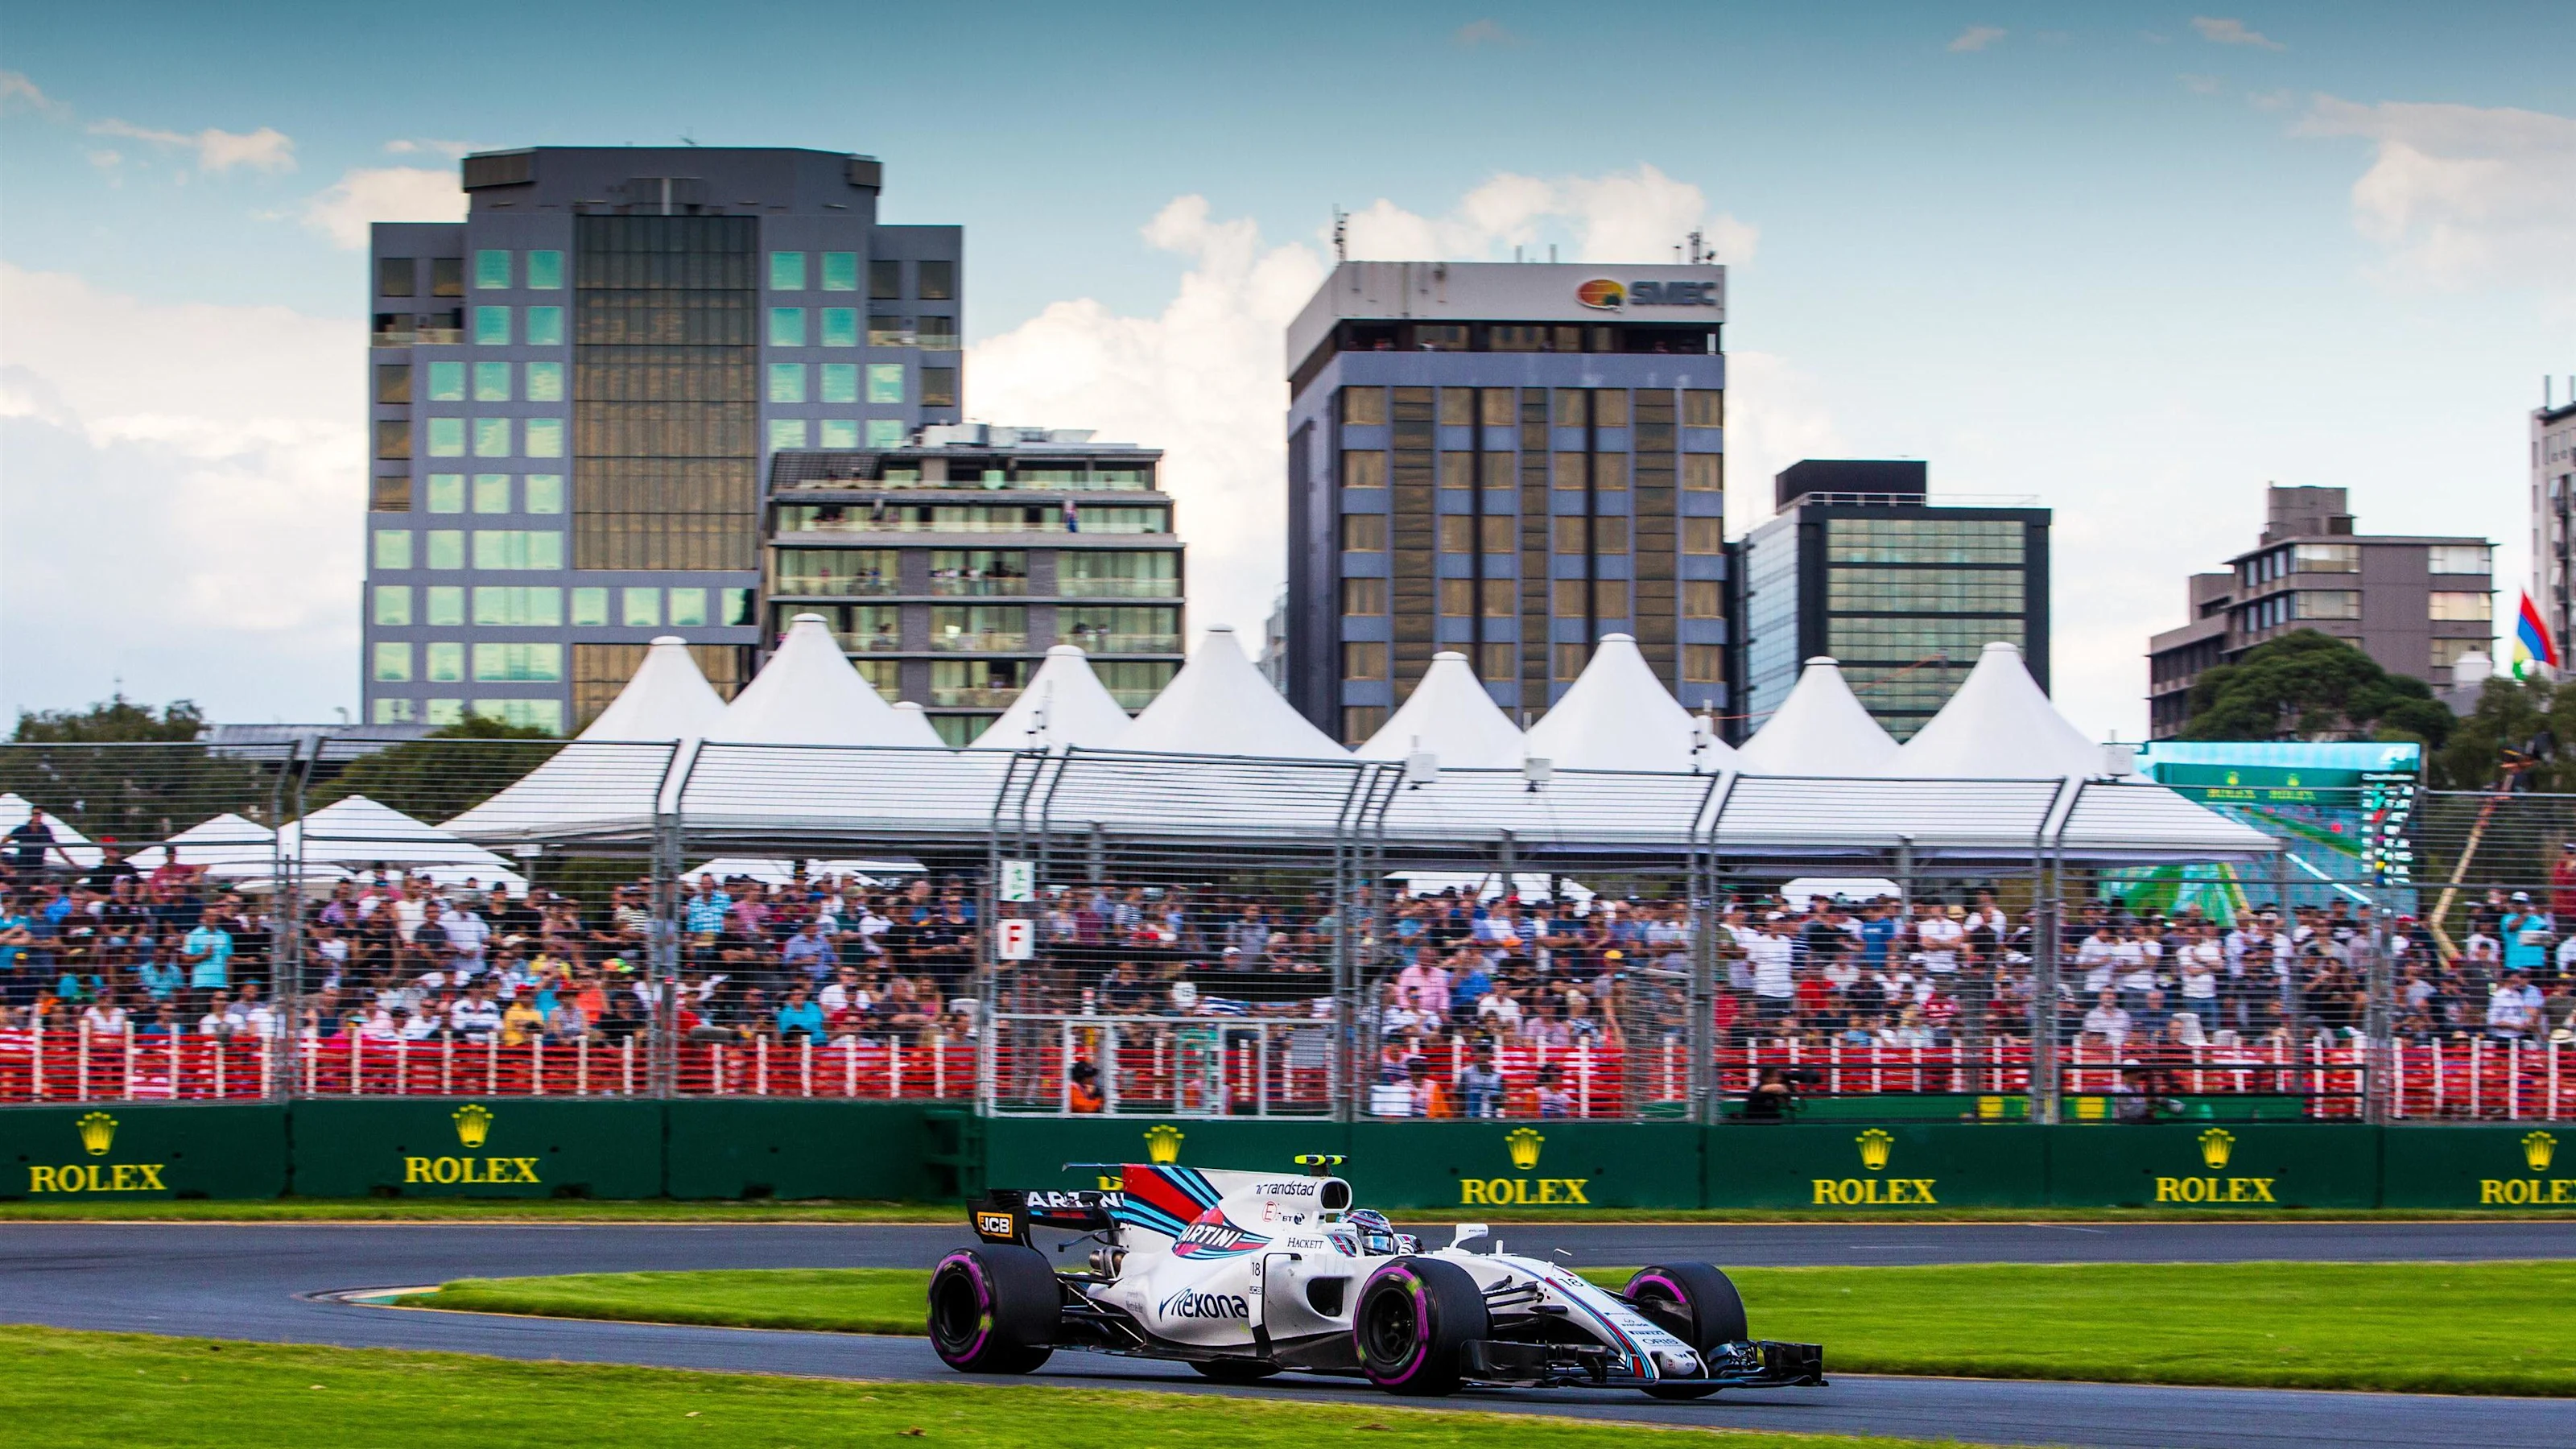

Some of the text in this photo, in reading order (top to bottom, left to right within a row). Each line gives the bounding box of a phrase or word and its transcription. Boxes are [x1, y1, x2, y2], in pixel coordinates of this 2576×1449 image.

[1630, 281, 1717, 306] SMEC
[27, 1164, 167, 1192] ROLEX
[403, 1156, 542, 1183] ROLEX
[1266, 1180, 1318, 1196] randstad
[1459, 1178, 1591, 1205] ROLEX
[1811, 1179, 1938, 1205] ROLEX
[2154, 1177, 2277, 1203] ROLEX
[2479, 1179, 2576, 1204] ROLE
[980, 1217, 1010, 1233] JCB
[1182, 1225, 1242, 1249] ARTINI
[1287, 1237, 1324, 1249] HACKETT
[1252, 1262, 1261, 1276] 18
[1558, 1278, 1583, 1287] 18
[1170, 1288, 1249, 1319] Rexona
